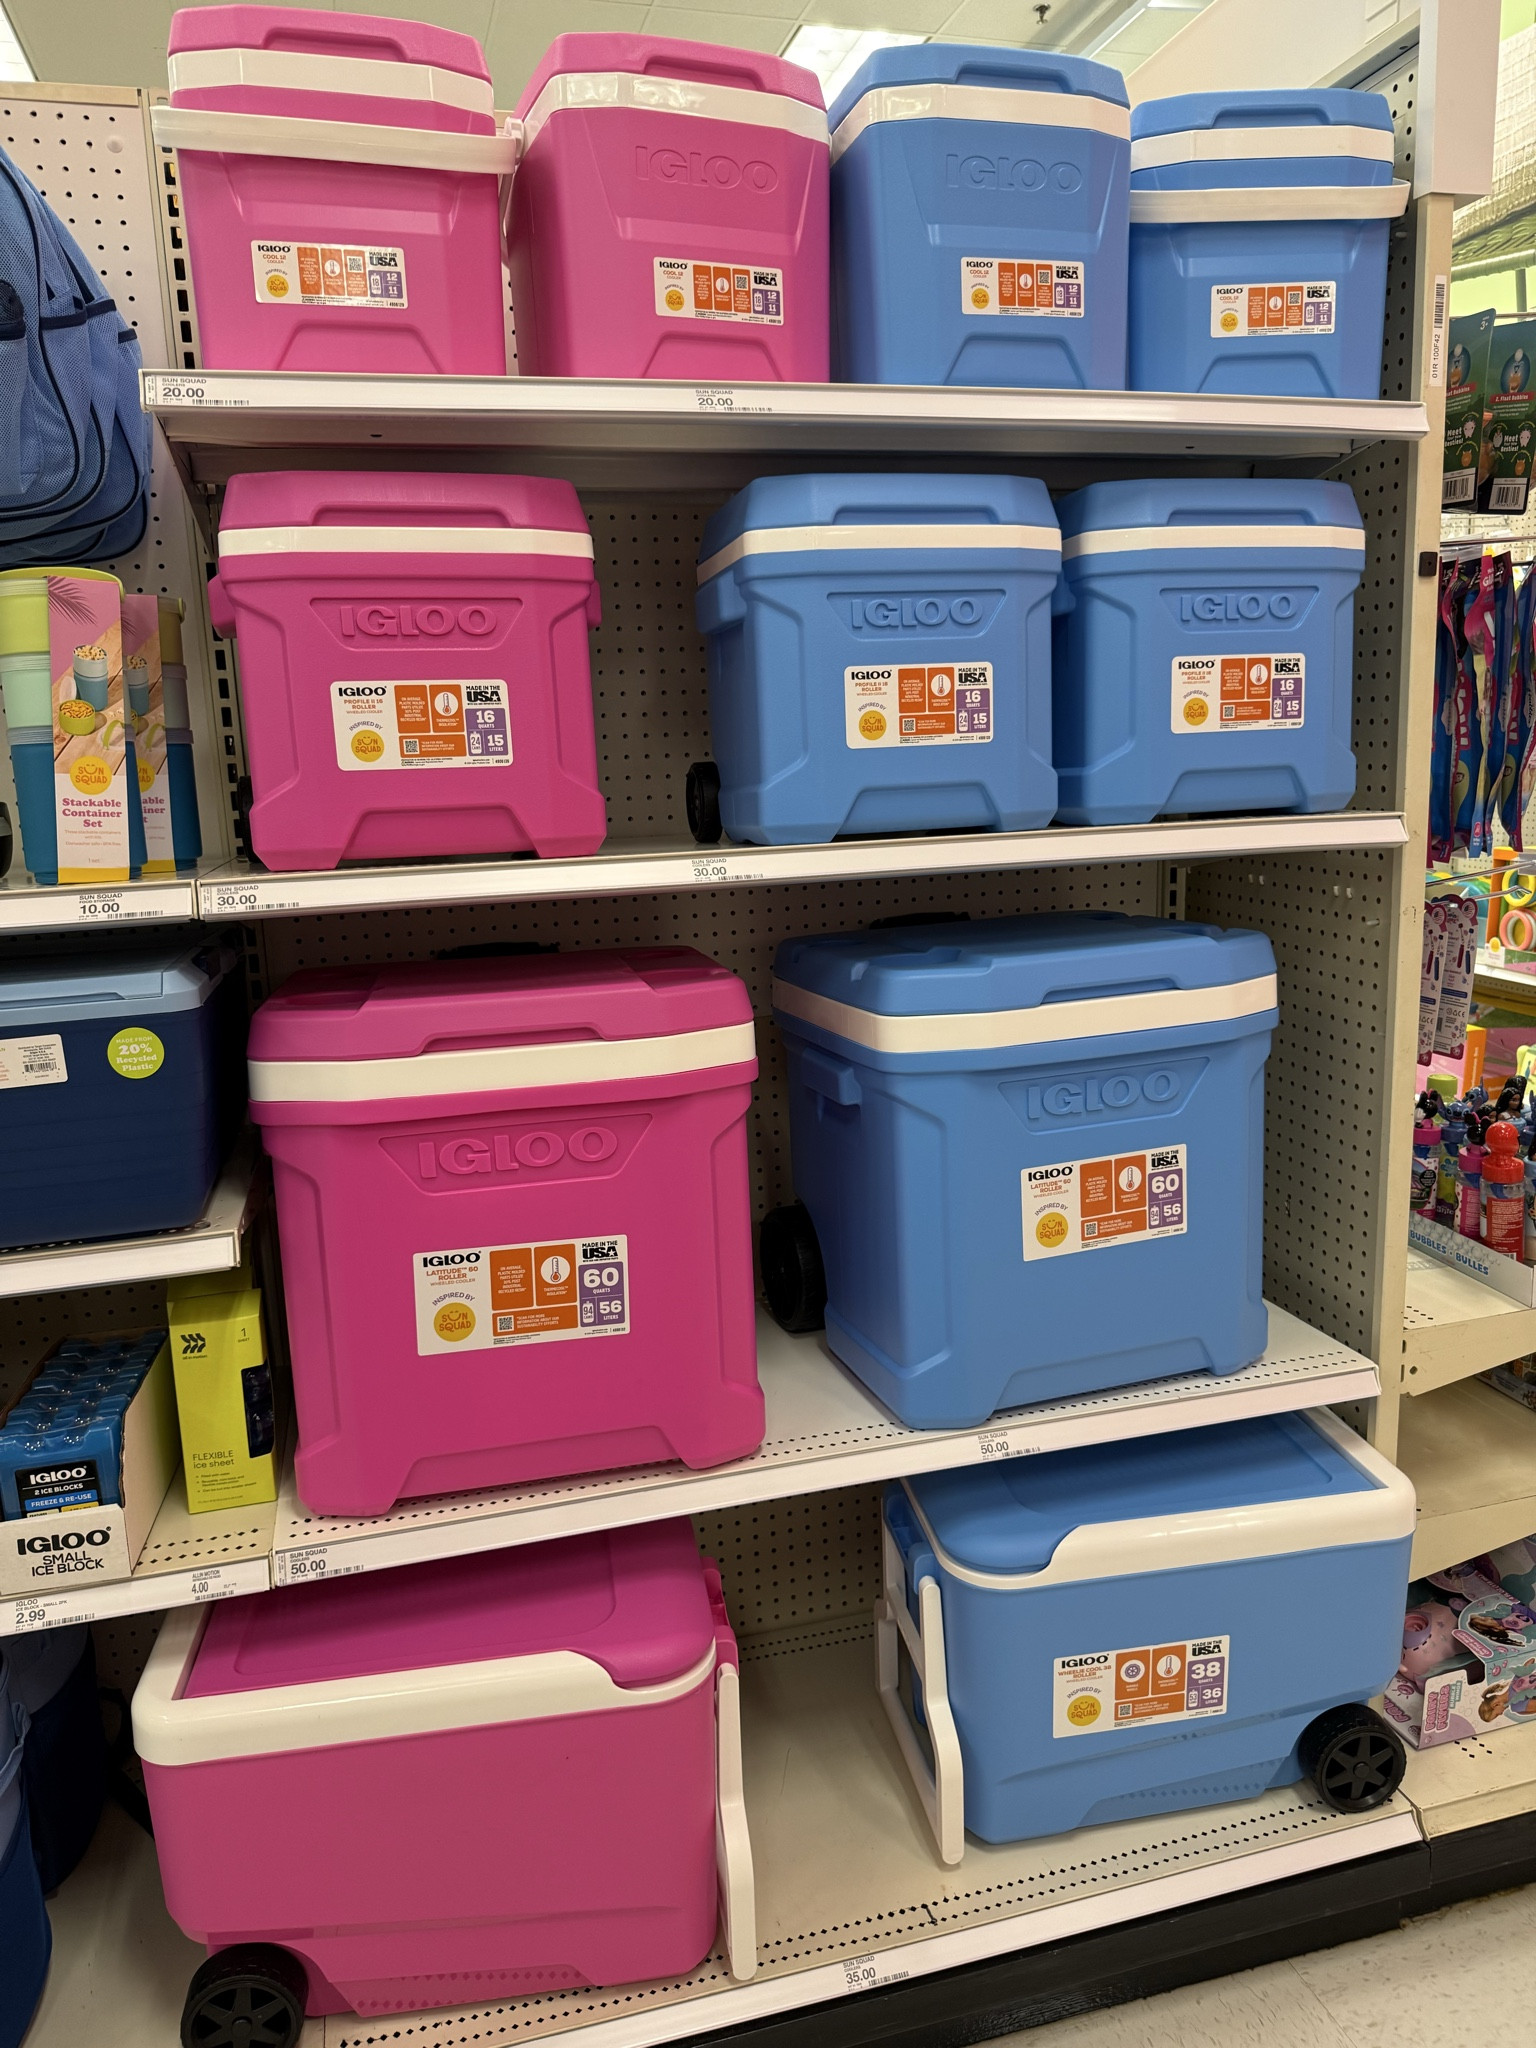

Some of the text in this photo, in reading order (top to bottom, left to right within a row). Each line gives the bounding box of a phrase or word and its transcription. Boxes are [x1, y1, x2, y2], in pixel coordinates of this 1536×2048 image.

[636, 145, 778, 194] IGLOO
[946, 154, 1082, 195] IGLOO
[370, 257, 397, 267] USA
[659, 261, 687, 270] IGLOO
[1056, 270, 1078, 279] USA
[754, 276, 777, 286] USA
[389, 286, 398, 294] 11
[1307, 290, 1330, 298] USA
[769, 304, 776, 312] 11
[163, 387, 204, 398] 20.00
[698, 398, 733, 406] 20.00
[852, 597, 982, 628] IGLOO
[1180, 593, 1297, 622] IGLOO
[340, 605, 497, 636] IGLOO
[1178, 660, 1214, 669] IGLOO
[1275, 663, 1300, 672] USA
[851, 671, 891, 680] IGLOO
[958, 673, 987, 683] USA
[1280, 680, 1294, 690] 16
[338, 687, 386, 696] IGLOO
[467, 691, 501, 702] USA
[965, 691, 981, 702] 16
[1286, 701, 1299, 710] 15
[476, 710, 494, 723] 16
[973, 713, 987, 723] 15
[488, 735, 504, 746] 15
[356, 746, 381, 754] SQUAD
[78, 767, 104, 775] SUN
[76, 775, 107, 785] SQUAD
[62, 798, 121, 807] Stackable
[62, 809, 122, 818] Container
[83, 820, 103, 828] Set
[694, 867, 727, 876] 30.00
[217, 895, 256, 906] 30.00
[80, 903, 120, 914] 10.00
[118, 1044, 152, 1055] 20%
[116, 1054, 157, 1064] Recycled
[122, 1064, 153, 1072] Plastic
[1028, 1070, 1180, 1120] IGLOO
[419, 1127, 618, 1178] IGLOO
[1151, 1154, 1179, 1168] USA
[1028, 1166, 1072, 1182] IGLOO
[1040, 1185, 1062, 1193] ROLLER
[1152, 1174, 1179, 1193] 60
[1035, 1203, 1060, 1216] INSPIRED
[1163, 1204, 1181, 1216] 56
[1042, 1222, 1062, 1231] SUN
[1040, 1229, 1065, 1240] SQUAD
[583, 1246, 618, 1259] USA
[1409, 1230, 1489, 1275] BUBBLES BULLES
[423, 1253, 480, 1267] IGLOO
[583, 1267, 619, 1288] 60
[432, 1292, 464, 1306] INSPIRED
[583, 1306, 593, 1315] 94
[599, 1300, 622, 1314] 56
[442, 1313, 468, 1322] SUN
[439, 1321, 471, 1332] SQUAD
[981, 1441, 1008, 1454] 50.00
[193, 1450, 234, 1461] FLEXIBLE
[30, 1467, 86, 1484] IGLOO
[54, 1483, 83, 1492] BLOCKS
[31, 1498, 58, 1507] FREEZE
[65, 1493, 92, 1502] RE-USE
[305, 1548, 327, 1556] SQUAD
[43, 1551, 91, 1565] SMALL
[32, 1558, 104, 1576] ICE BLOCK
[291, 1559, 326, 1574] 50.00
[192, 1581, 208, 1594] 4.00
[16, 1599, 38, 1607] IGLOO
[16, 1609, 45, 1624] 2.99
[1192, 1645, 1222, 1657] USA
[1061, 1656, 1108, 1669] IGLOO
[1191, 1662, 1221, 1679] 38
[1202, 1688, 1222, 1699] 36
[1071, 1710, 1097, 1719] SQUAD
[856, 1956, 875, 1965] SQUAD
[846, 1967, 876, 1984] 35.00
